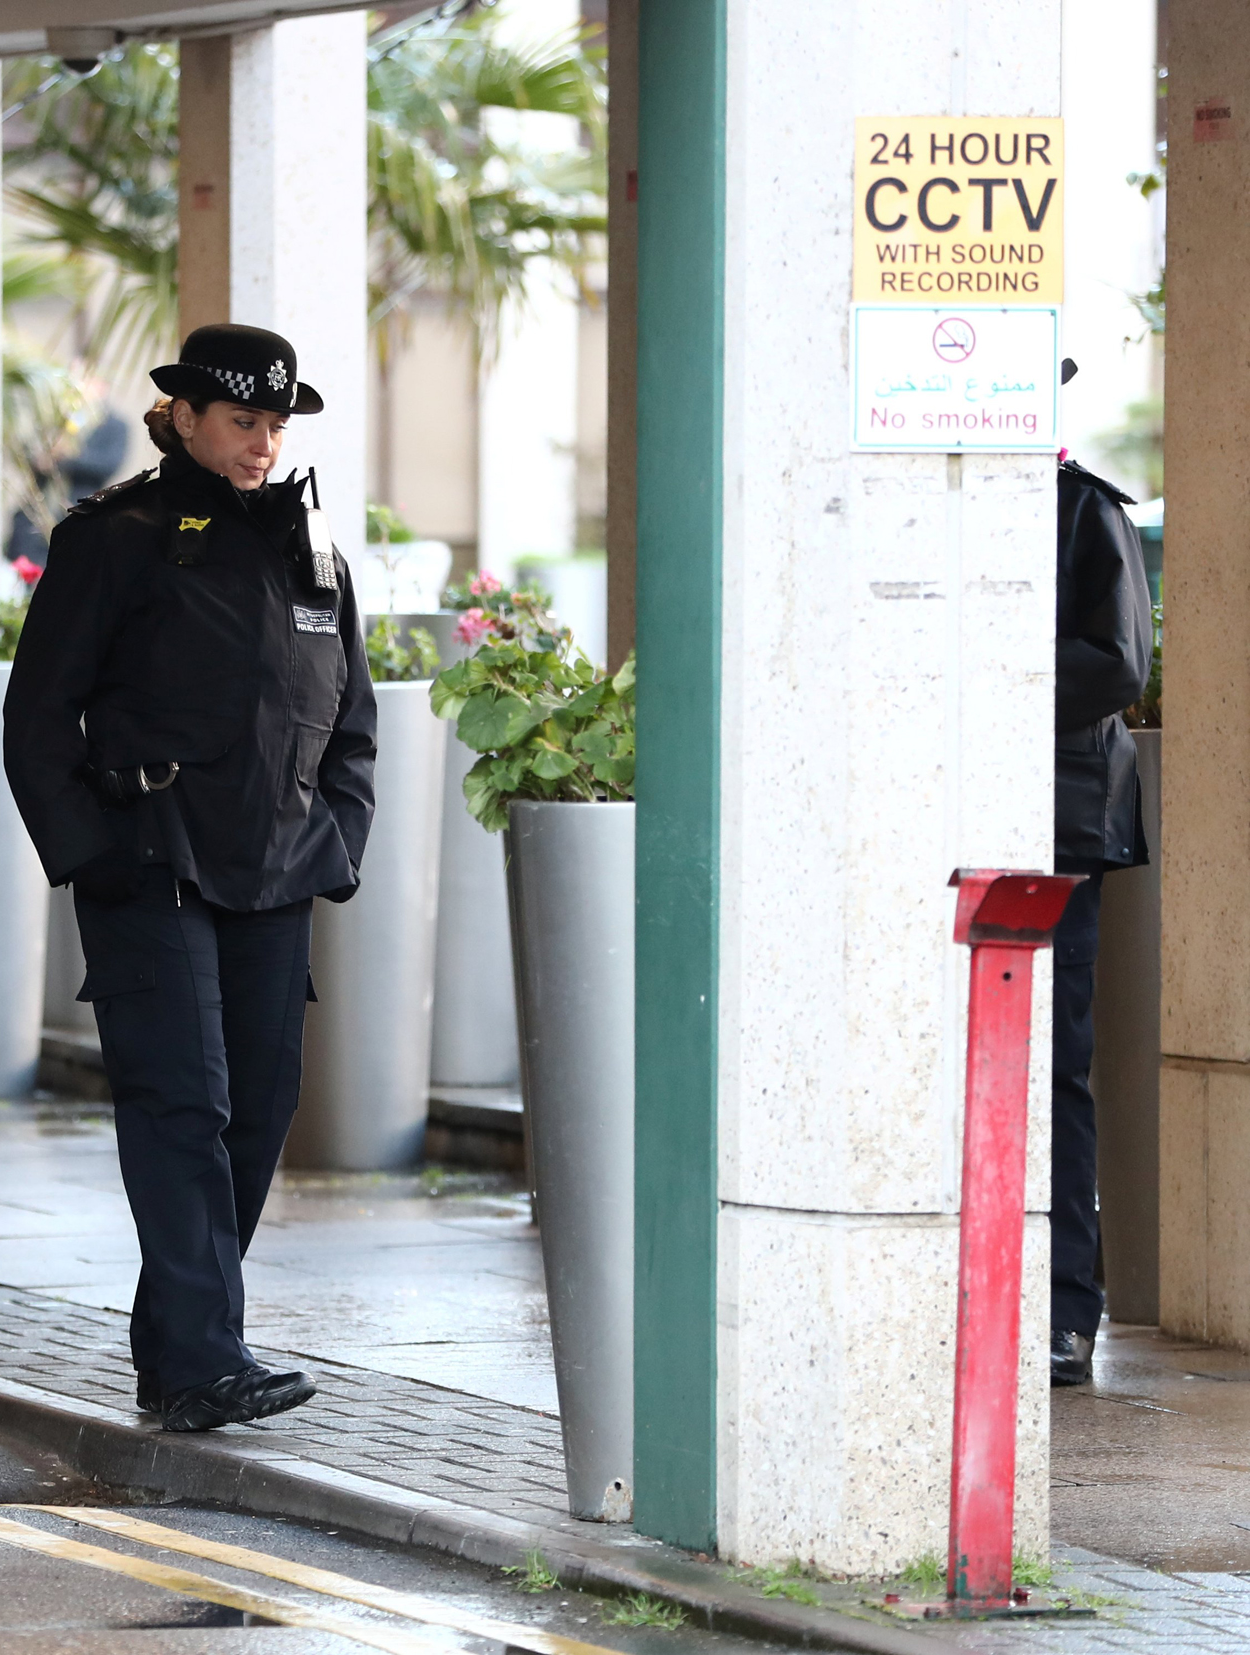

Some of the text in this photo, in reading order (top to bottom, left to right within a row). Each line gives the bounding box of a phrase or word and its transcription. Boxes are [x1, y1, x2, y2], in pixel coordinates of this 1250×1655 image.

[869, 132, 1053, 166] 24 HOUR
[864, 176, 1058, 233] CCTV
[876, 243, 1044, 264] WITH SOUND
[881, 271, 1040, 292] RECORDING
[875, 374, 1036, 402] ممنوع التدخين
[870, 407, 1038, 435] No smoking
[296, 623, 337, 634] POLICE OFFICER
